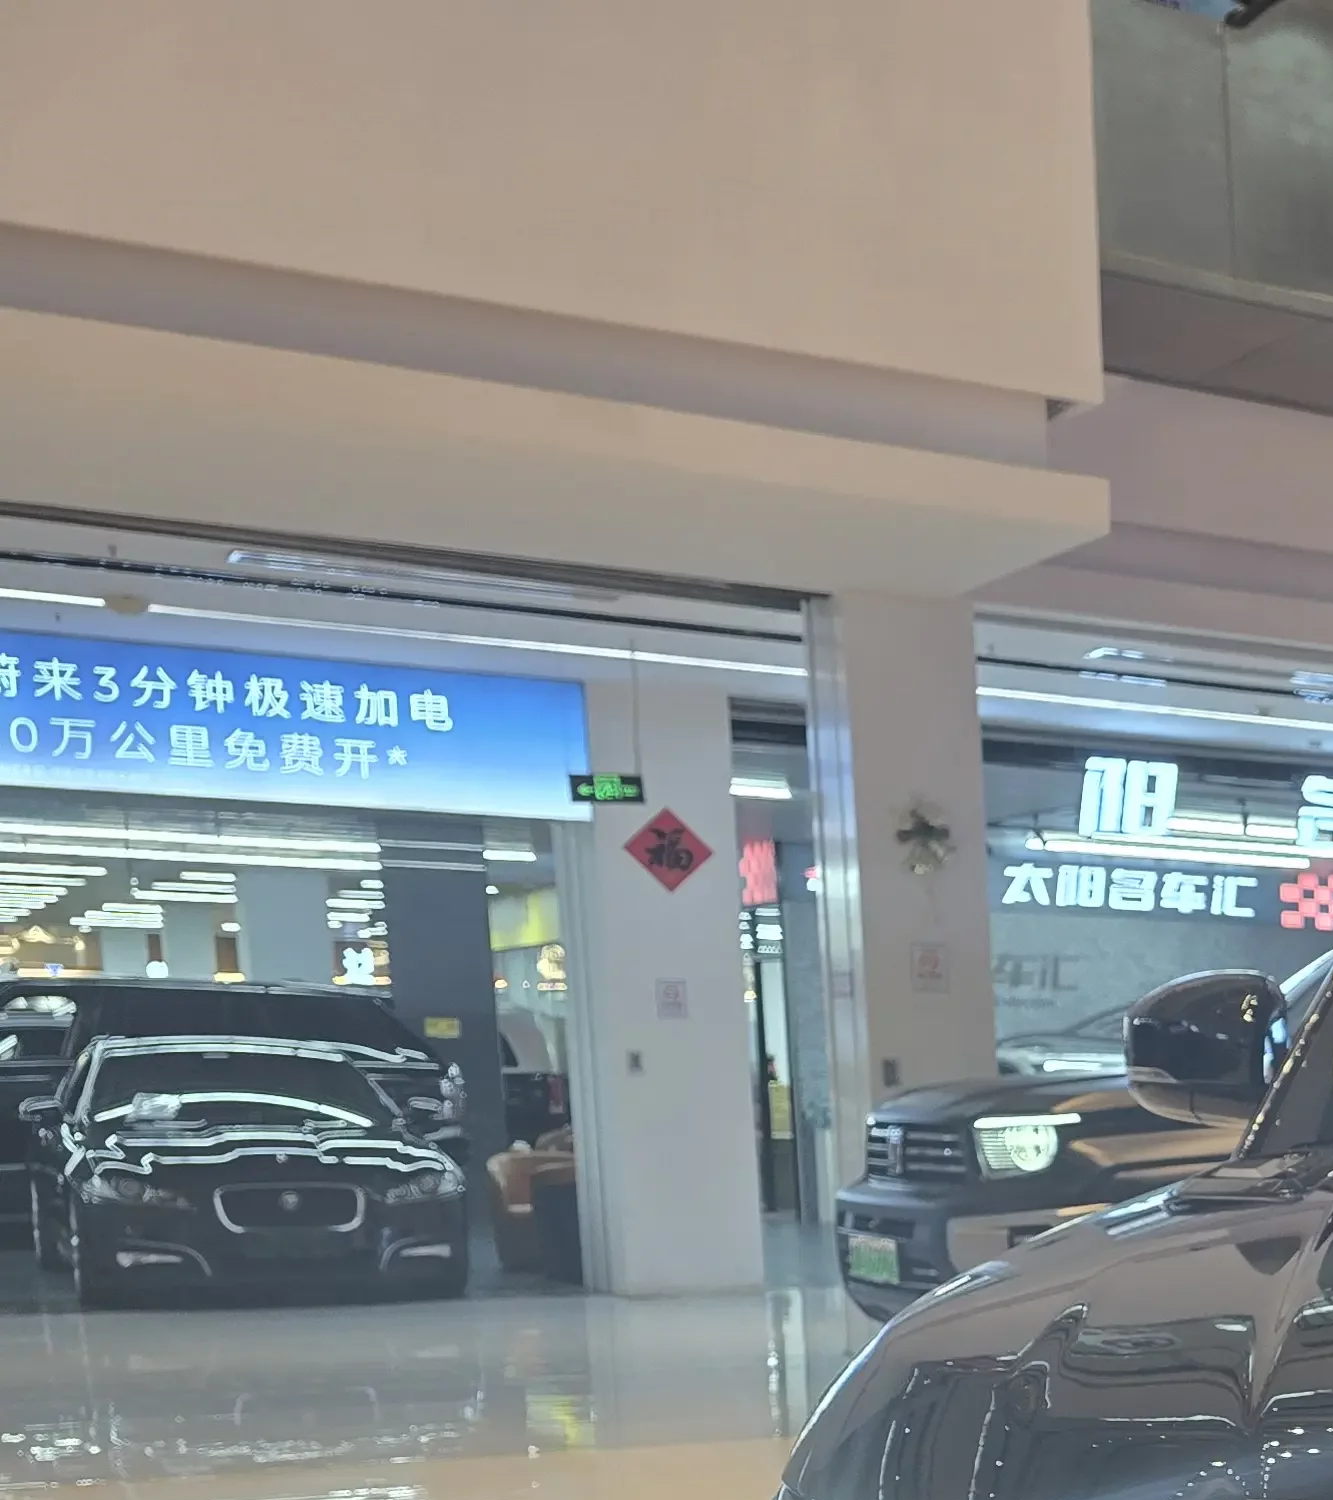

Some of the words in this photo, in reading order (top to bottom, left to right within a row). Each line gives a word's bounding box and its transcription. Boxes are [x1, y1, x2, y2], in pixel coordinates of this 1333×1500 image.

[1001, 862, 1259, 918] 太阳名车汇
